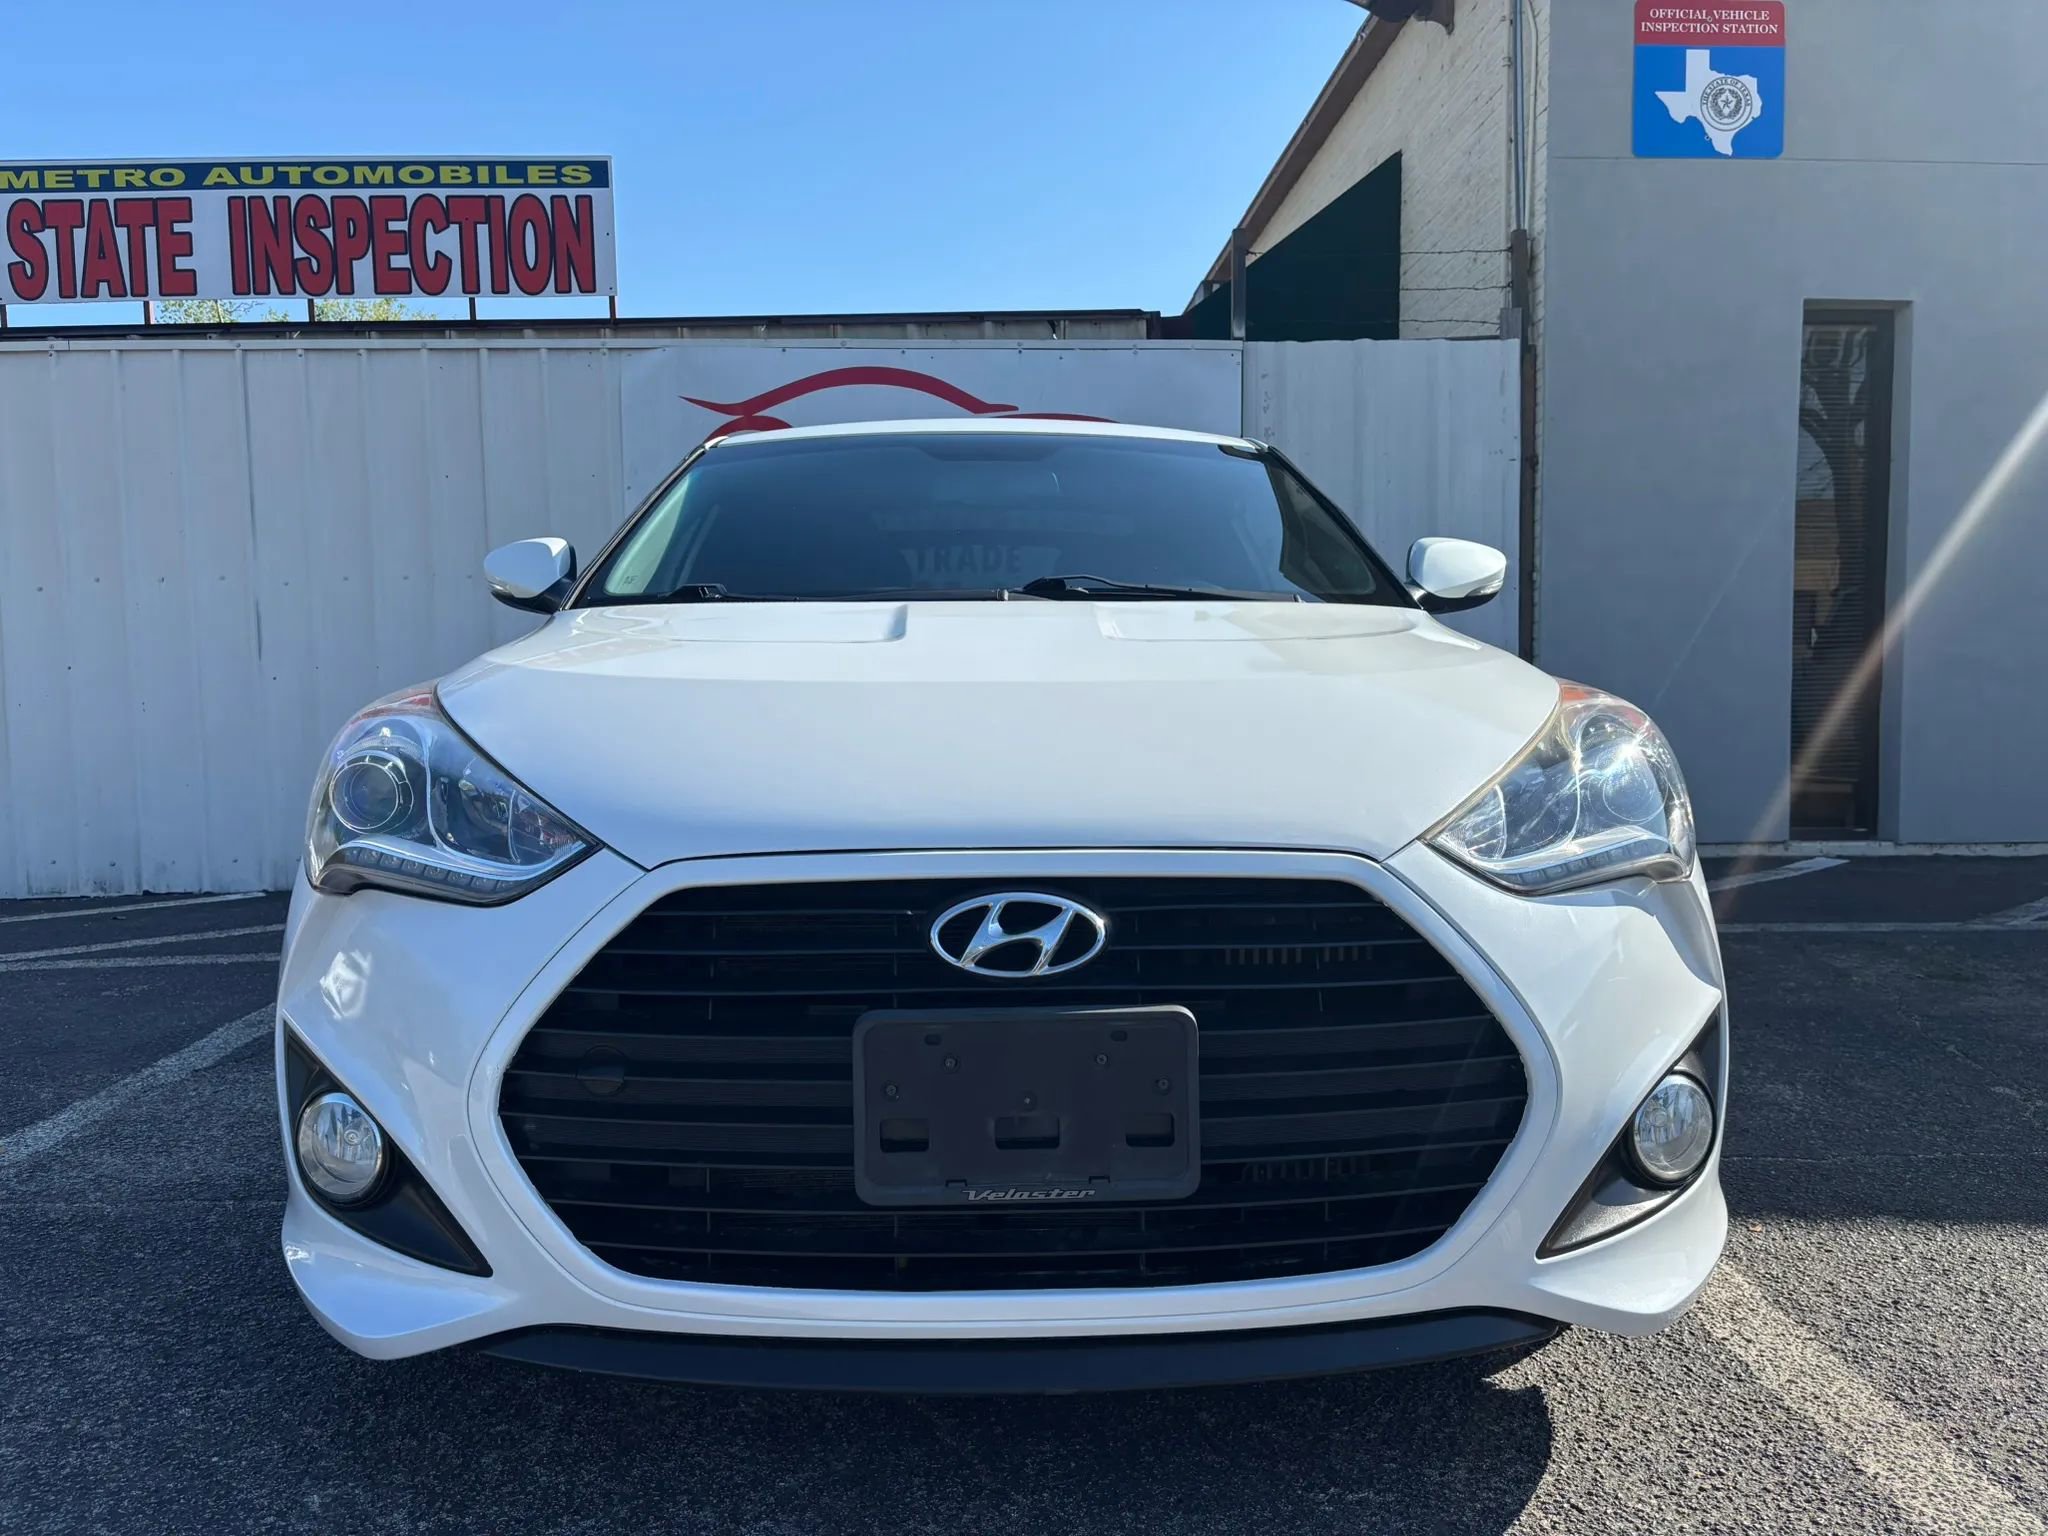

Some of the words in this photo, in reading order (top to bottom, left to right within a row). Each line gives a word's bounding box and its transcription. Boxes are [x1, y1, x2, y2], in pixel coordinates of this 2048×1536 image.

[1649, 8, 1709, 20] OFFICIAL
[1713, 10, 1770, 21] VEHICLE
[1641, 22, 1719, 34] INSPECTION
[1722, 24, 1778, 34] STATION
[0, 167, 186, 189] METRO
[202, 164, 593, 186] AUTOMOBILES
[6, 197, 197, 301] STATE
[227, 193, 597, 296] INSPECTION
[962, 1188, 1096, 1201] Veloster
